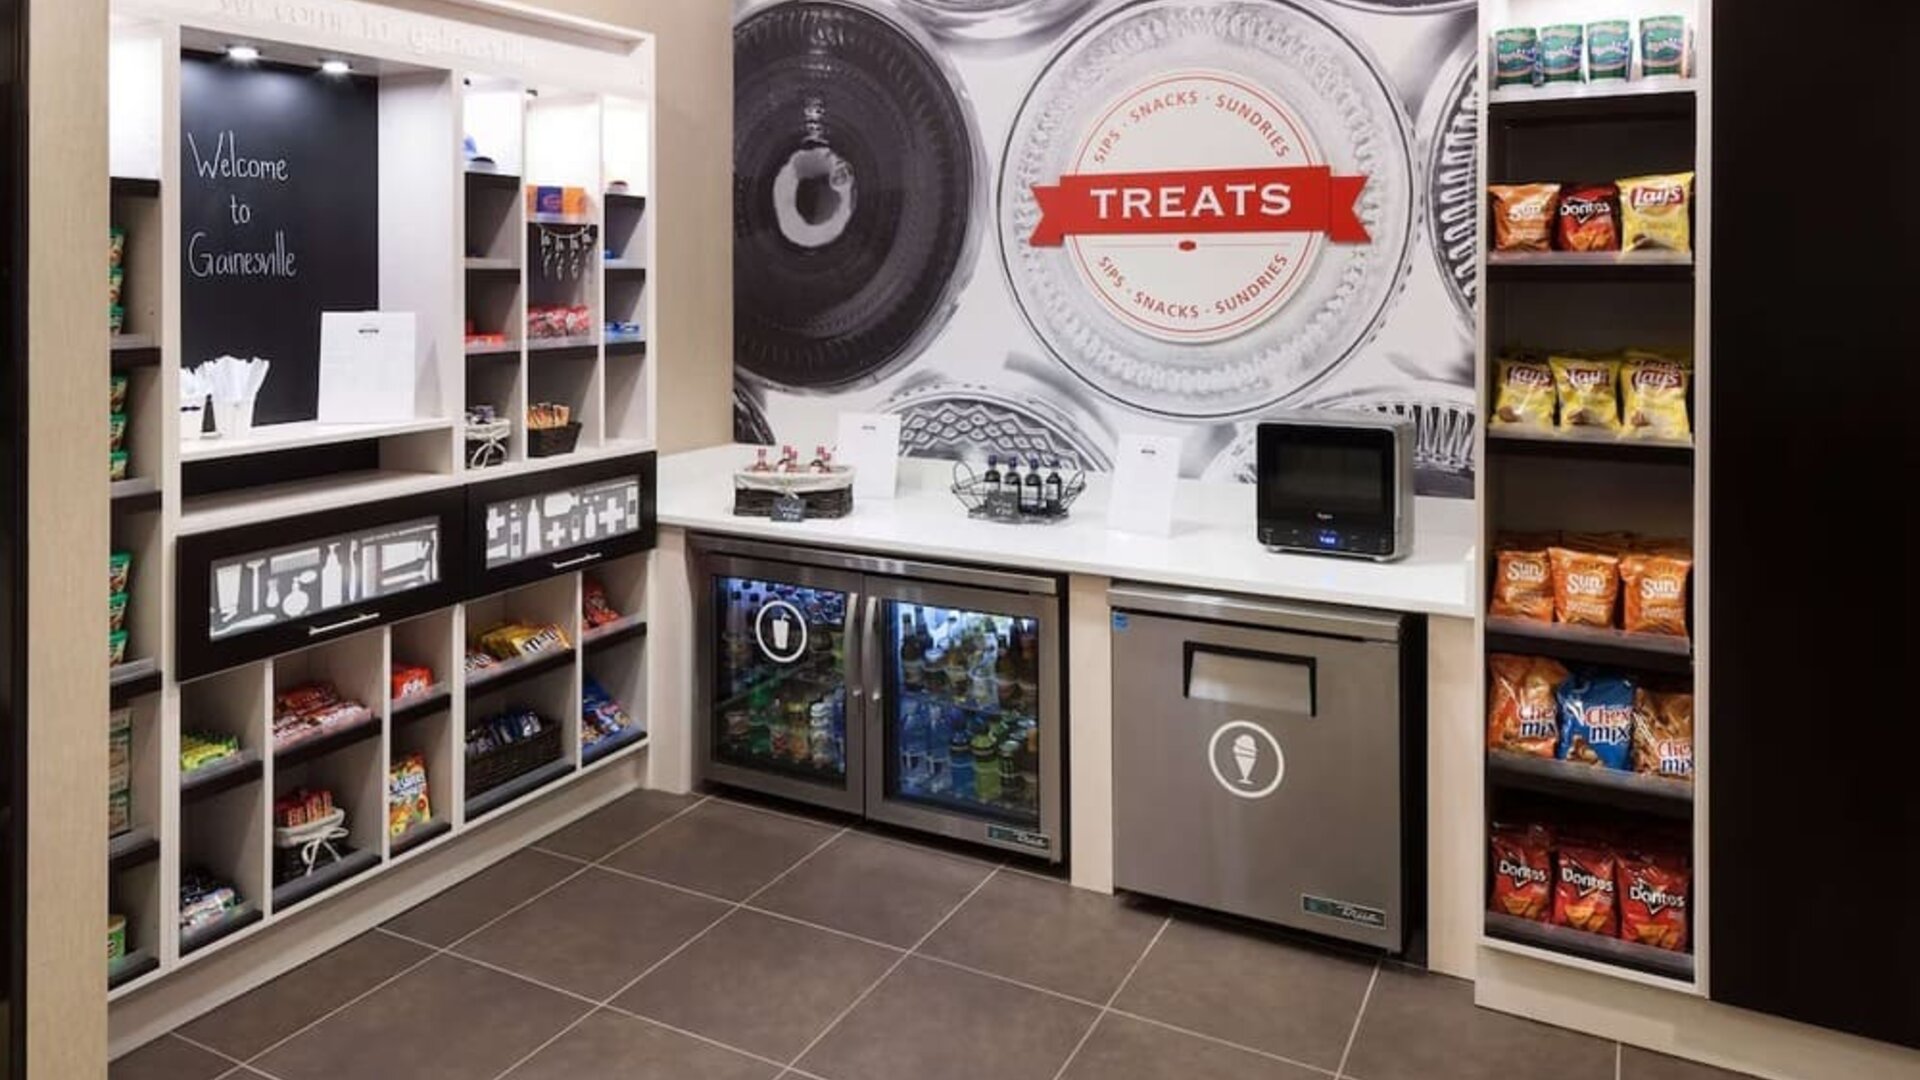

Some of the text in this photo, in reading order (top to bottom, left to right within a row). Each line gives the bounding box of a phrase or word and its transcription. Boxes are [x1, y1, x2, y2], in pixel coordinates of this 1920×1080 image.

[1094, 90, 1291, 164] SIPS SNACKS SUNDRIES
[187, 130, 289, 181] Welcome
[229, 194, 251, 225] to
[1090, 183, 1292, 220] TREATS
[1560, 202, 1611, 217] Doritos
[188, 229, 297, 277] Gainesville
[1097, 253, 1289, 319] SIPS SNACKS SUNDRIES
[1507, 561, 1541, 581] Sun
[1566, 574, 1606, 594] Sun
[1640, 578, 1681, 599] Sun
[1585, 706, 1632, 726] Chex
[1590, 725, 1630, 744] mix
[1657, 739, 1691, 758] Che
[1500, 859, 1547, 883] Doritos
[1561, 867, 1614, 893] Doritos
[1629, 885, 1686, 909] Doritos
